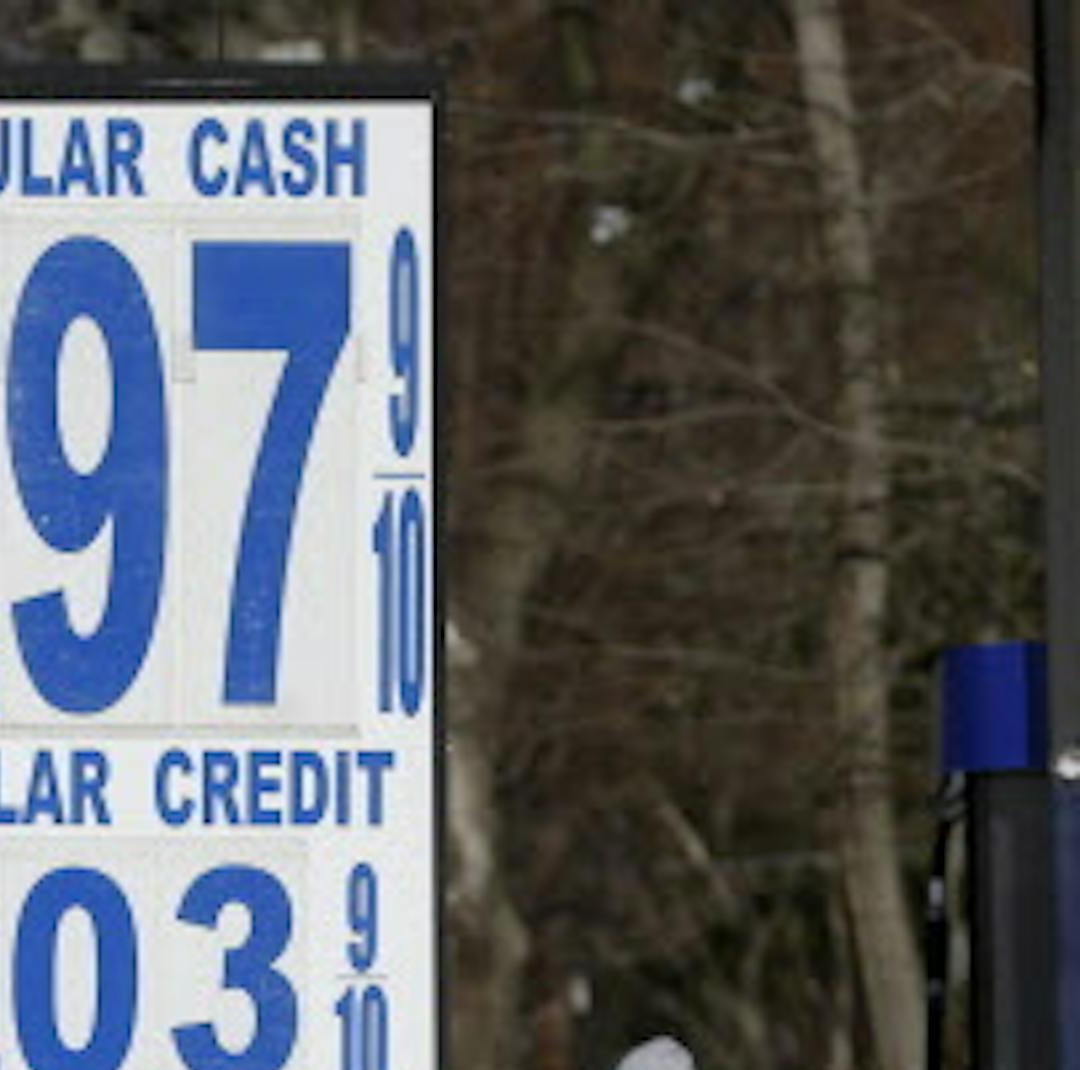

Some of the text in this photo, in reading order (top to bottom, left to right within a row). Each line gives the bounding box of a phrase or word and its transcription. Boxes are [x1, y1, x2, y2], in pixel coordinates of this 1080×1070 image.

[189, 118, 367, 198] CASH
[390, 228, 420, 457] 9
[373, 490, 425, 720] 10
[154, 749, 396, 827] CREDIT
[345, 862, 377, 972] 9
